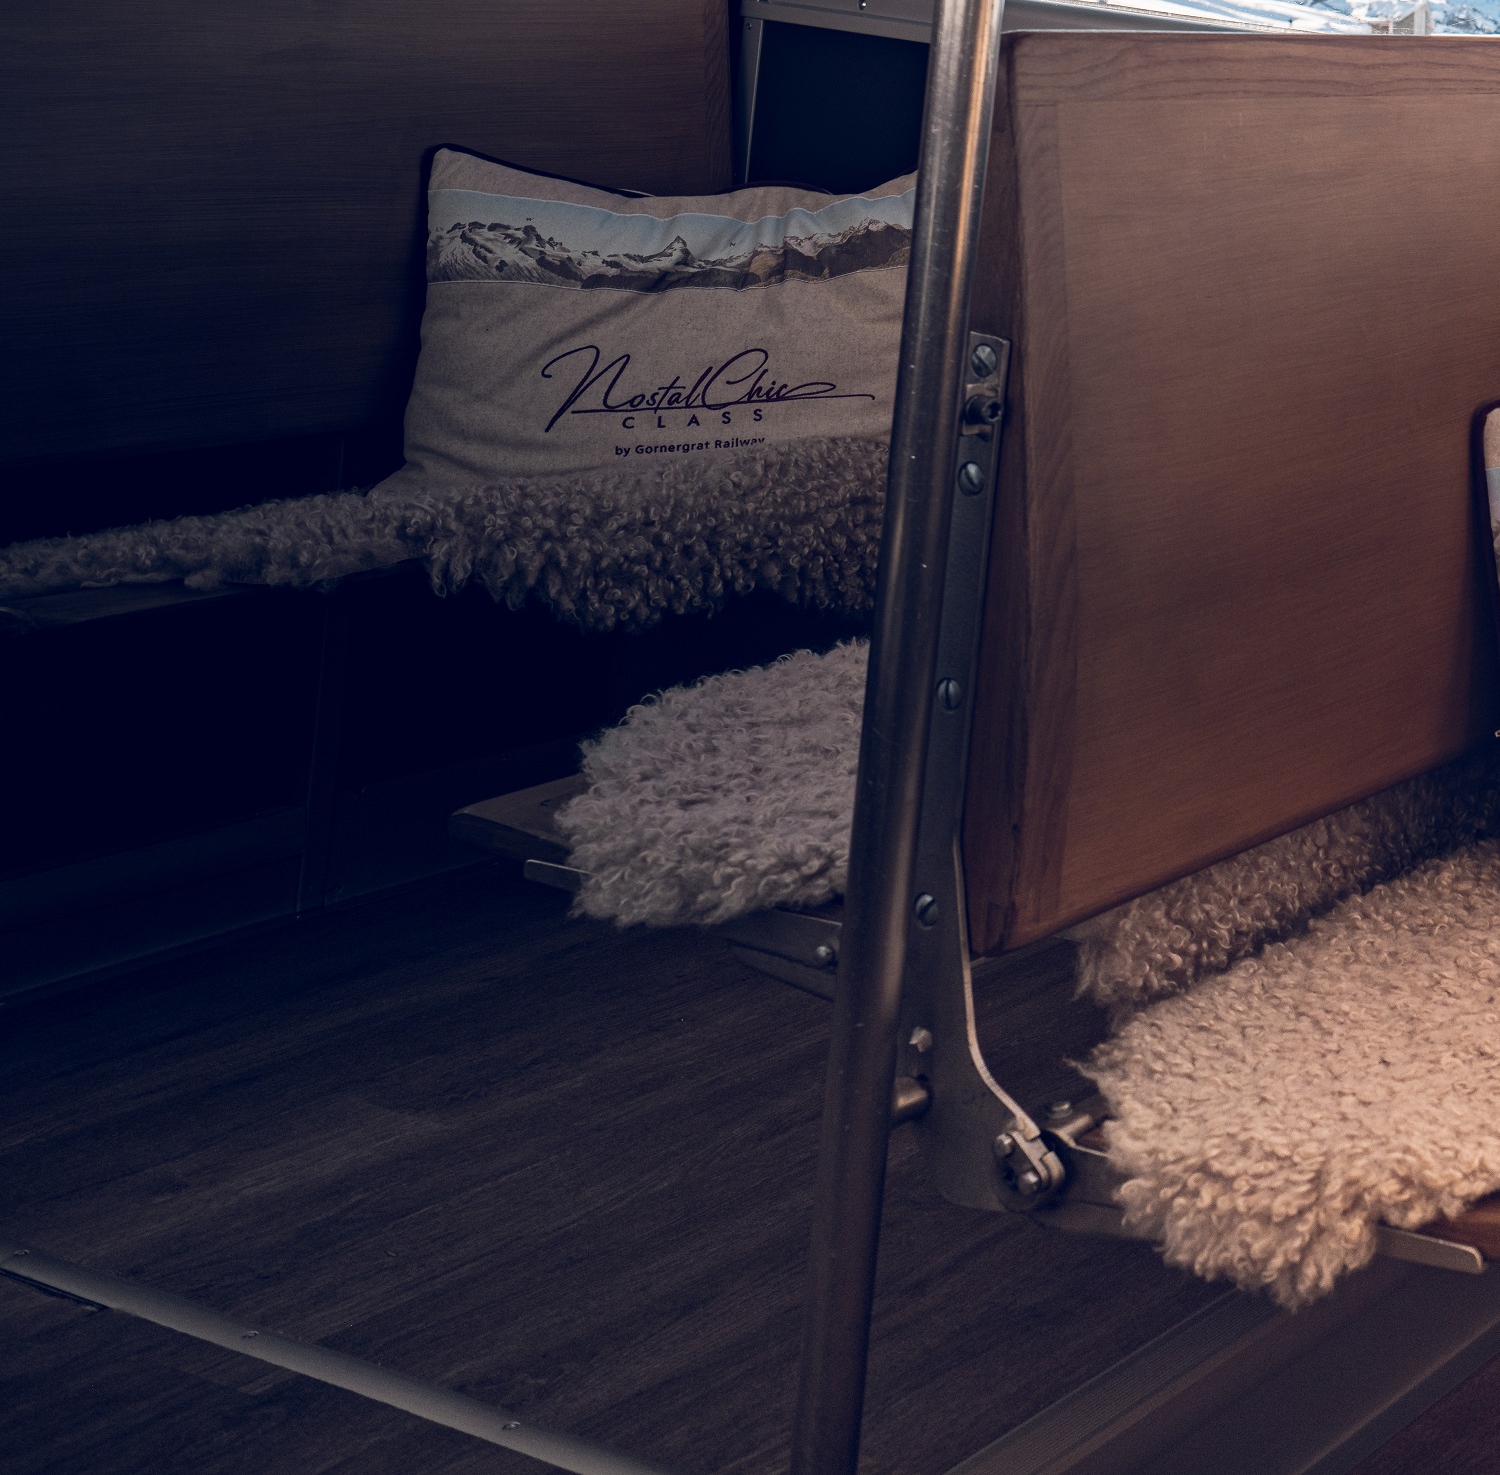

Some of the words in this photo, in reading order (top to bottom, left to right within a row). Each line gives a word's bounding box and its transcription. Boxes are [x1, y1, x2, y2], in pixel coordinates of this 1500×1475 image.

[621, 407, 764, 430] CLASS
[614, 445, 631, 458] by
[635, 440, 711, 455] Gornergrat
